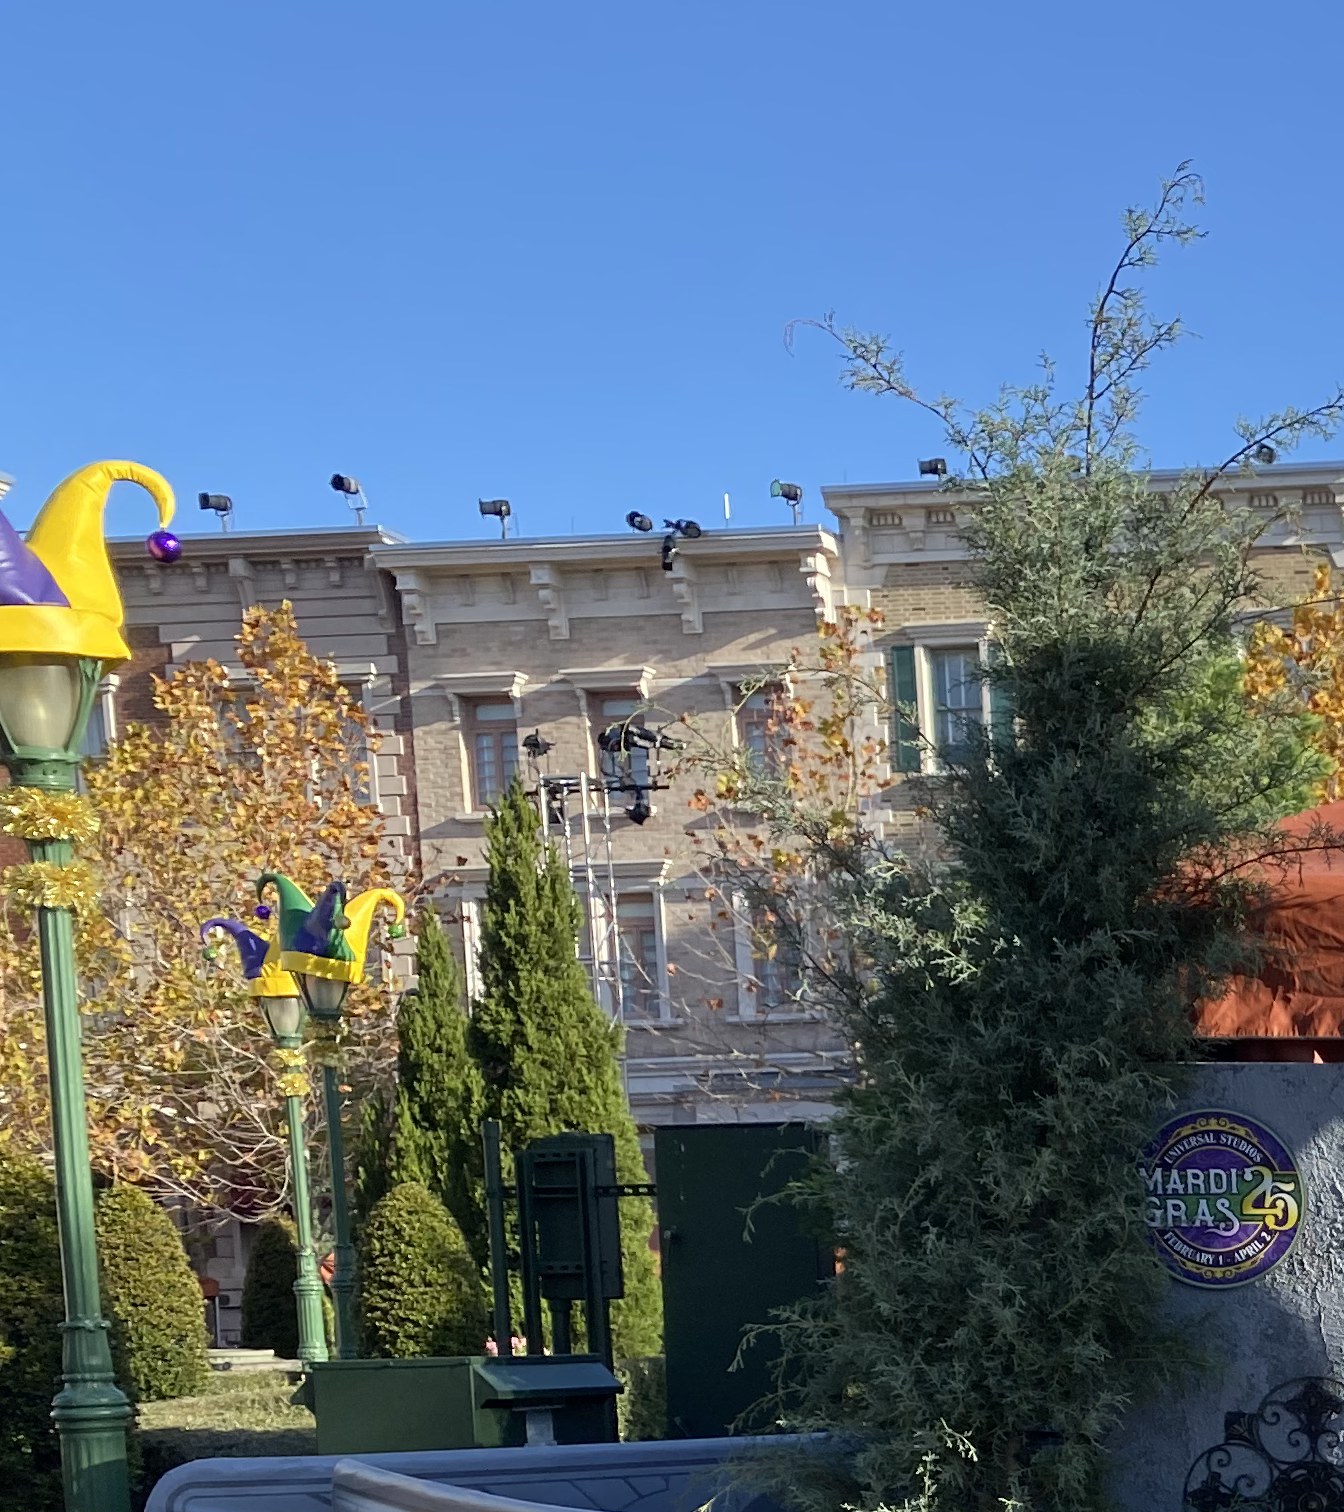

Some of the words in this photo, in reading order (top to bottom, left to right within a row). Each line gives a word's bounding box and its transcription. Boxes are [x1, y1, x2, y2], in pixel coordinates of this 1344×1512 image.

[1163, 1133, 1217, 1164] UNIVERSAL
[1218, 1133, 1264, 1163] STUDIOS
[1139, 1167, 1240, 1194] MARDI
[1241, 1165, 1300, 1231] 25
[1144, 1197, 1241, 1237] GRAS
[1163, 1231, 1216, 1265] FEBRUARY
[1233, 1240, 1266, 1265] APRIL
